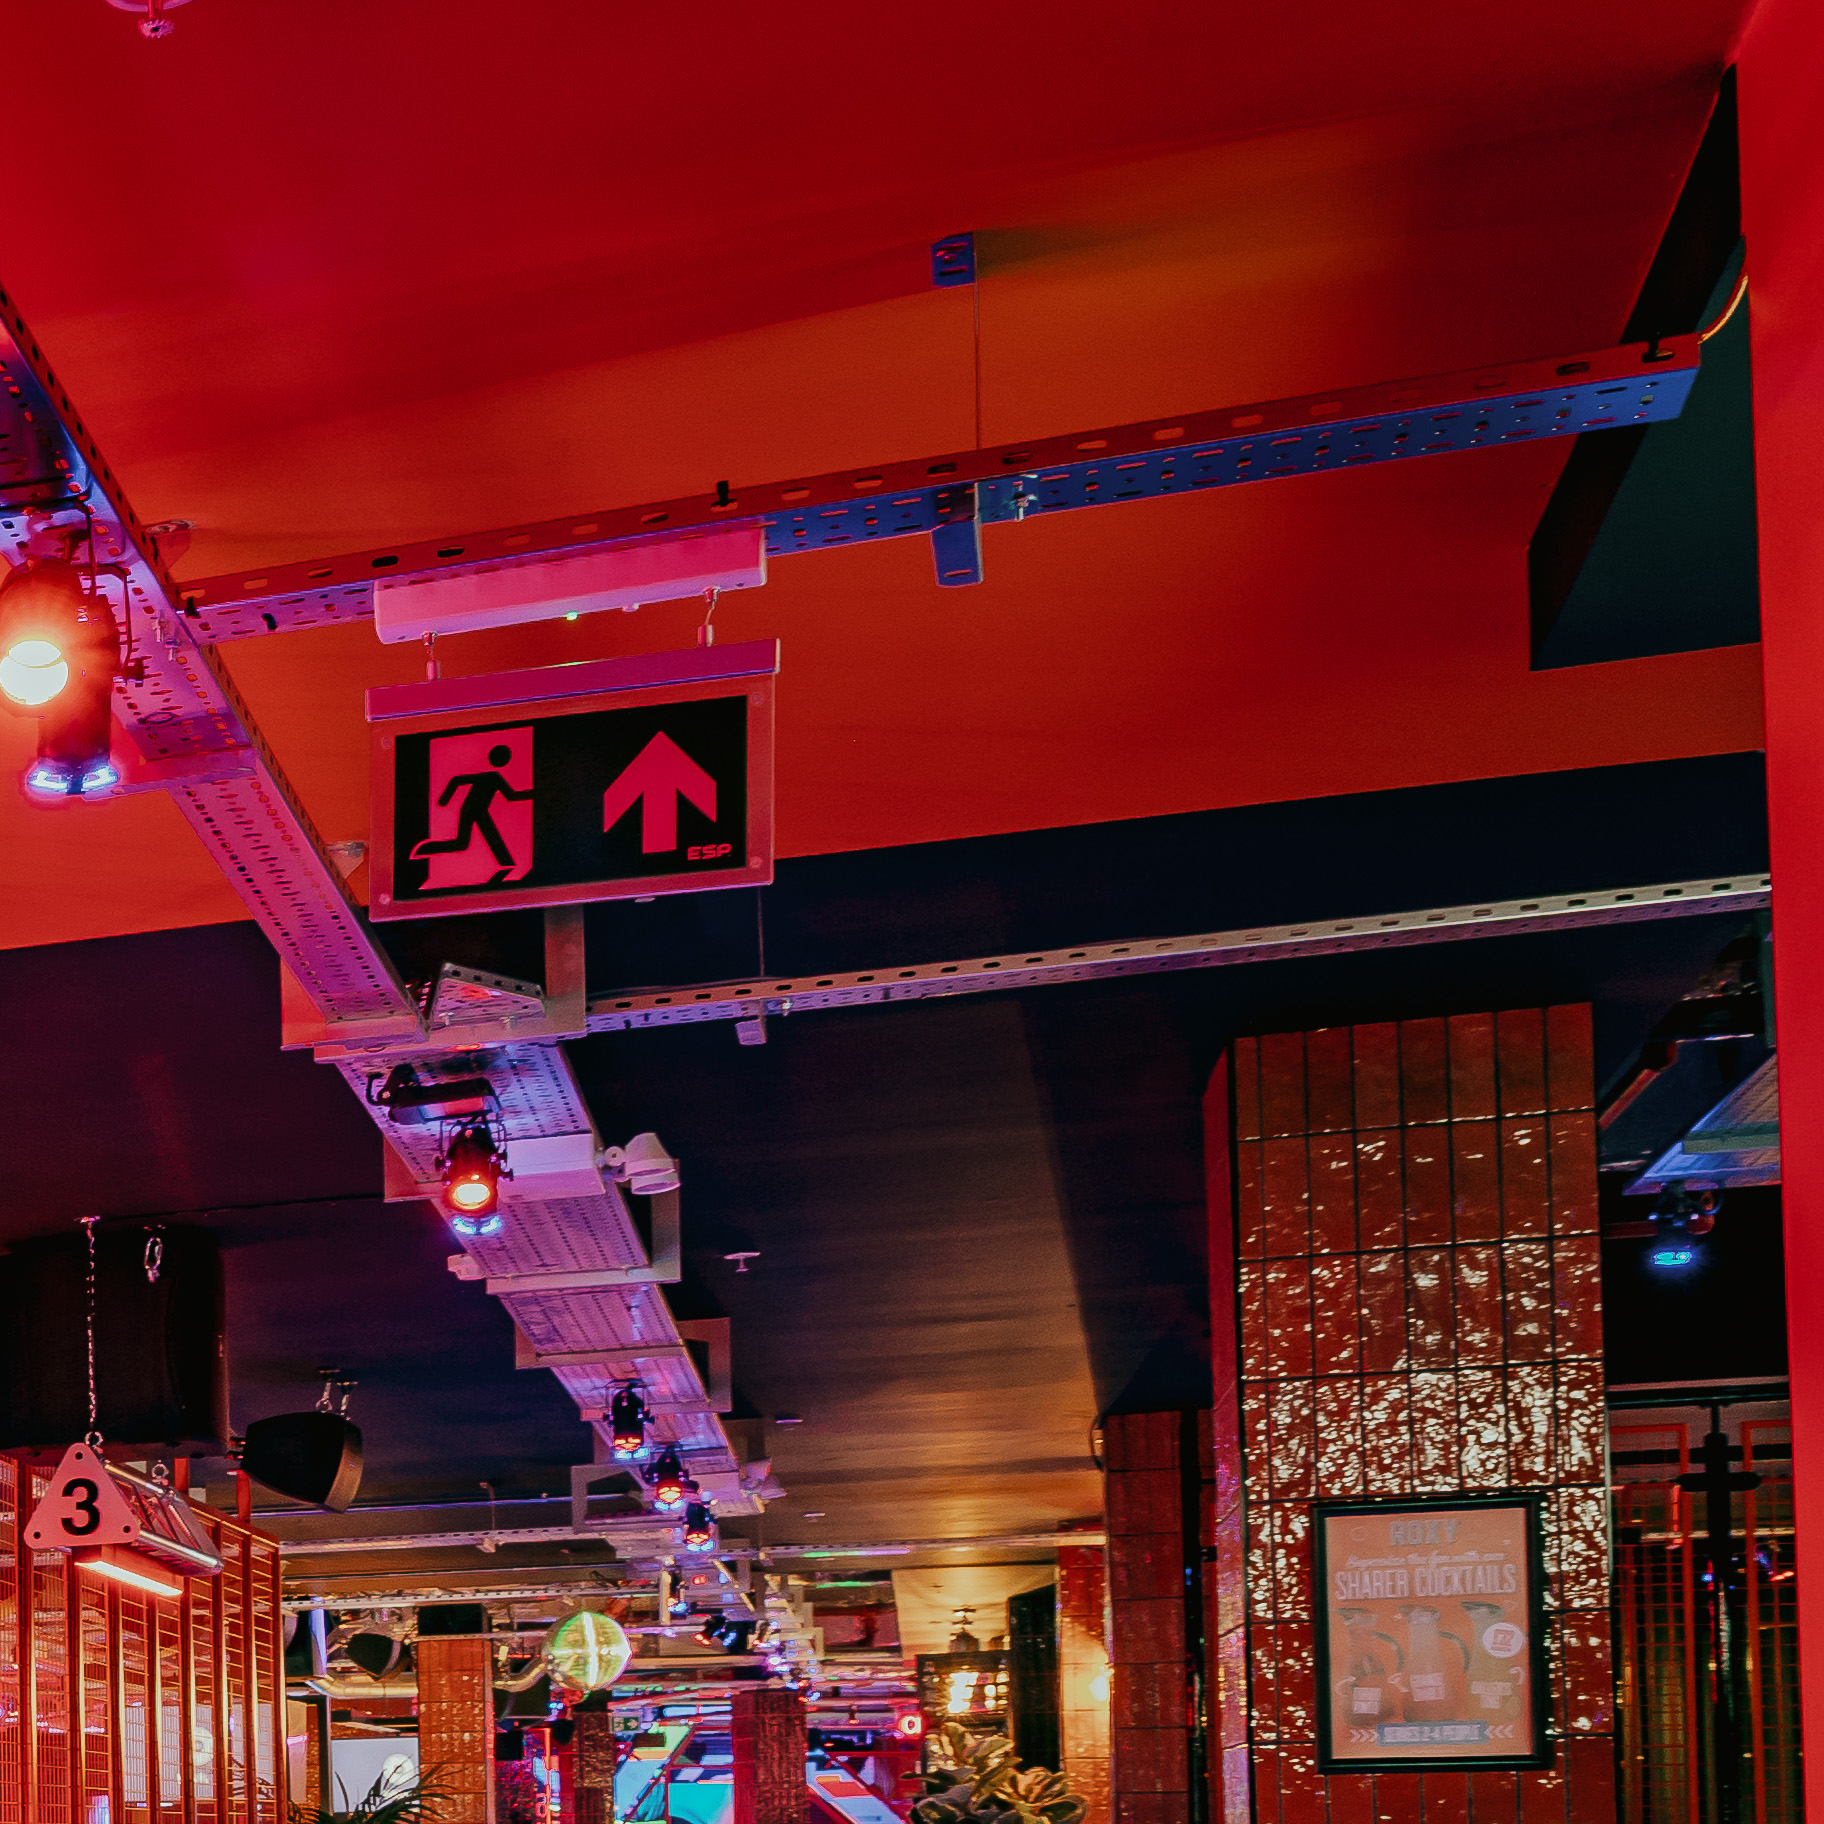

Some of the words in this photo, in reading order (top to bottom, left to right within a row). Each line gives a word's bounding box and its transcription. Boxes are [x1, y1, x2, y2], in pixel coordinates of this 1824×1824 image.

[687, 843, 732, 860] ESP
[60, 1477, 101, 1536] 3
[1389, 1519, 1459, 1547] ROXY
[1414, 1563, 1517, 1598] COCKTAILS
